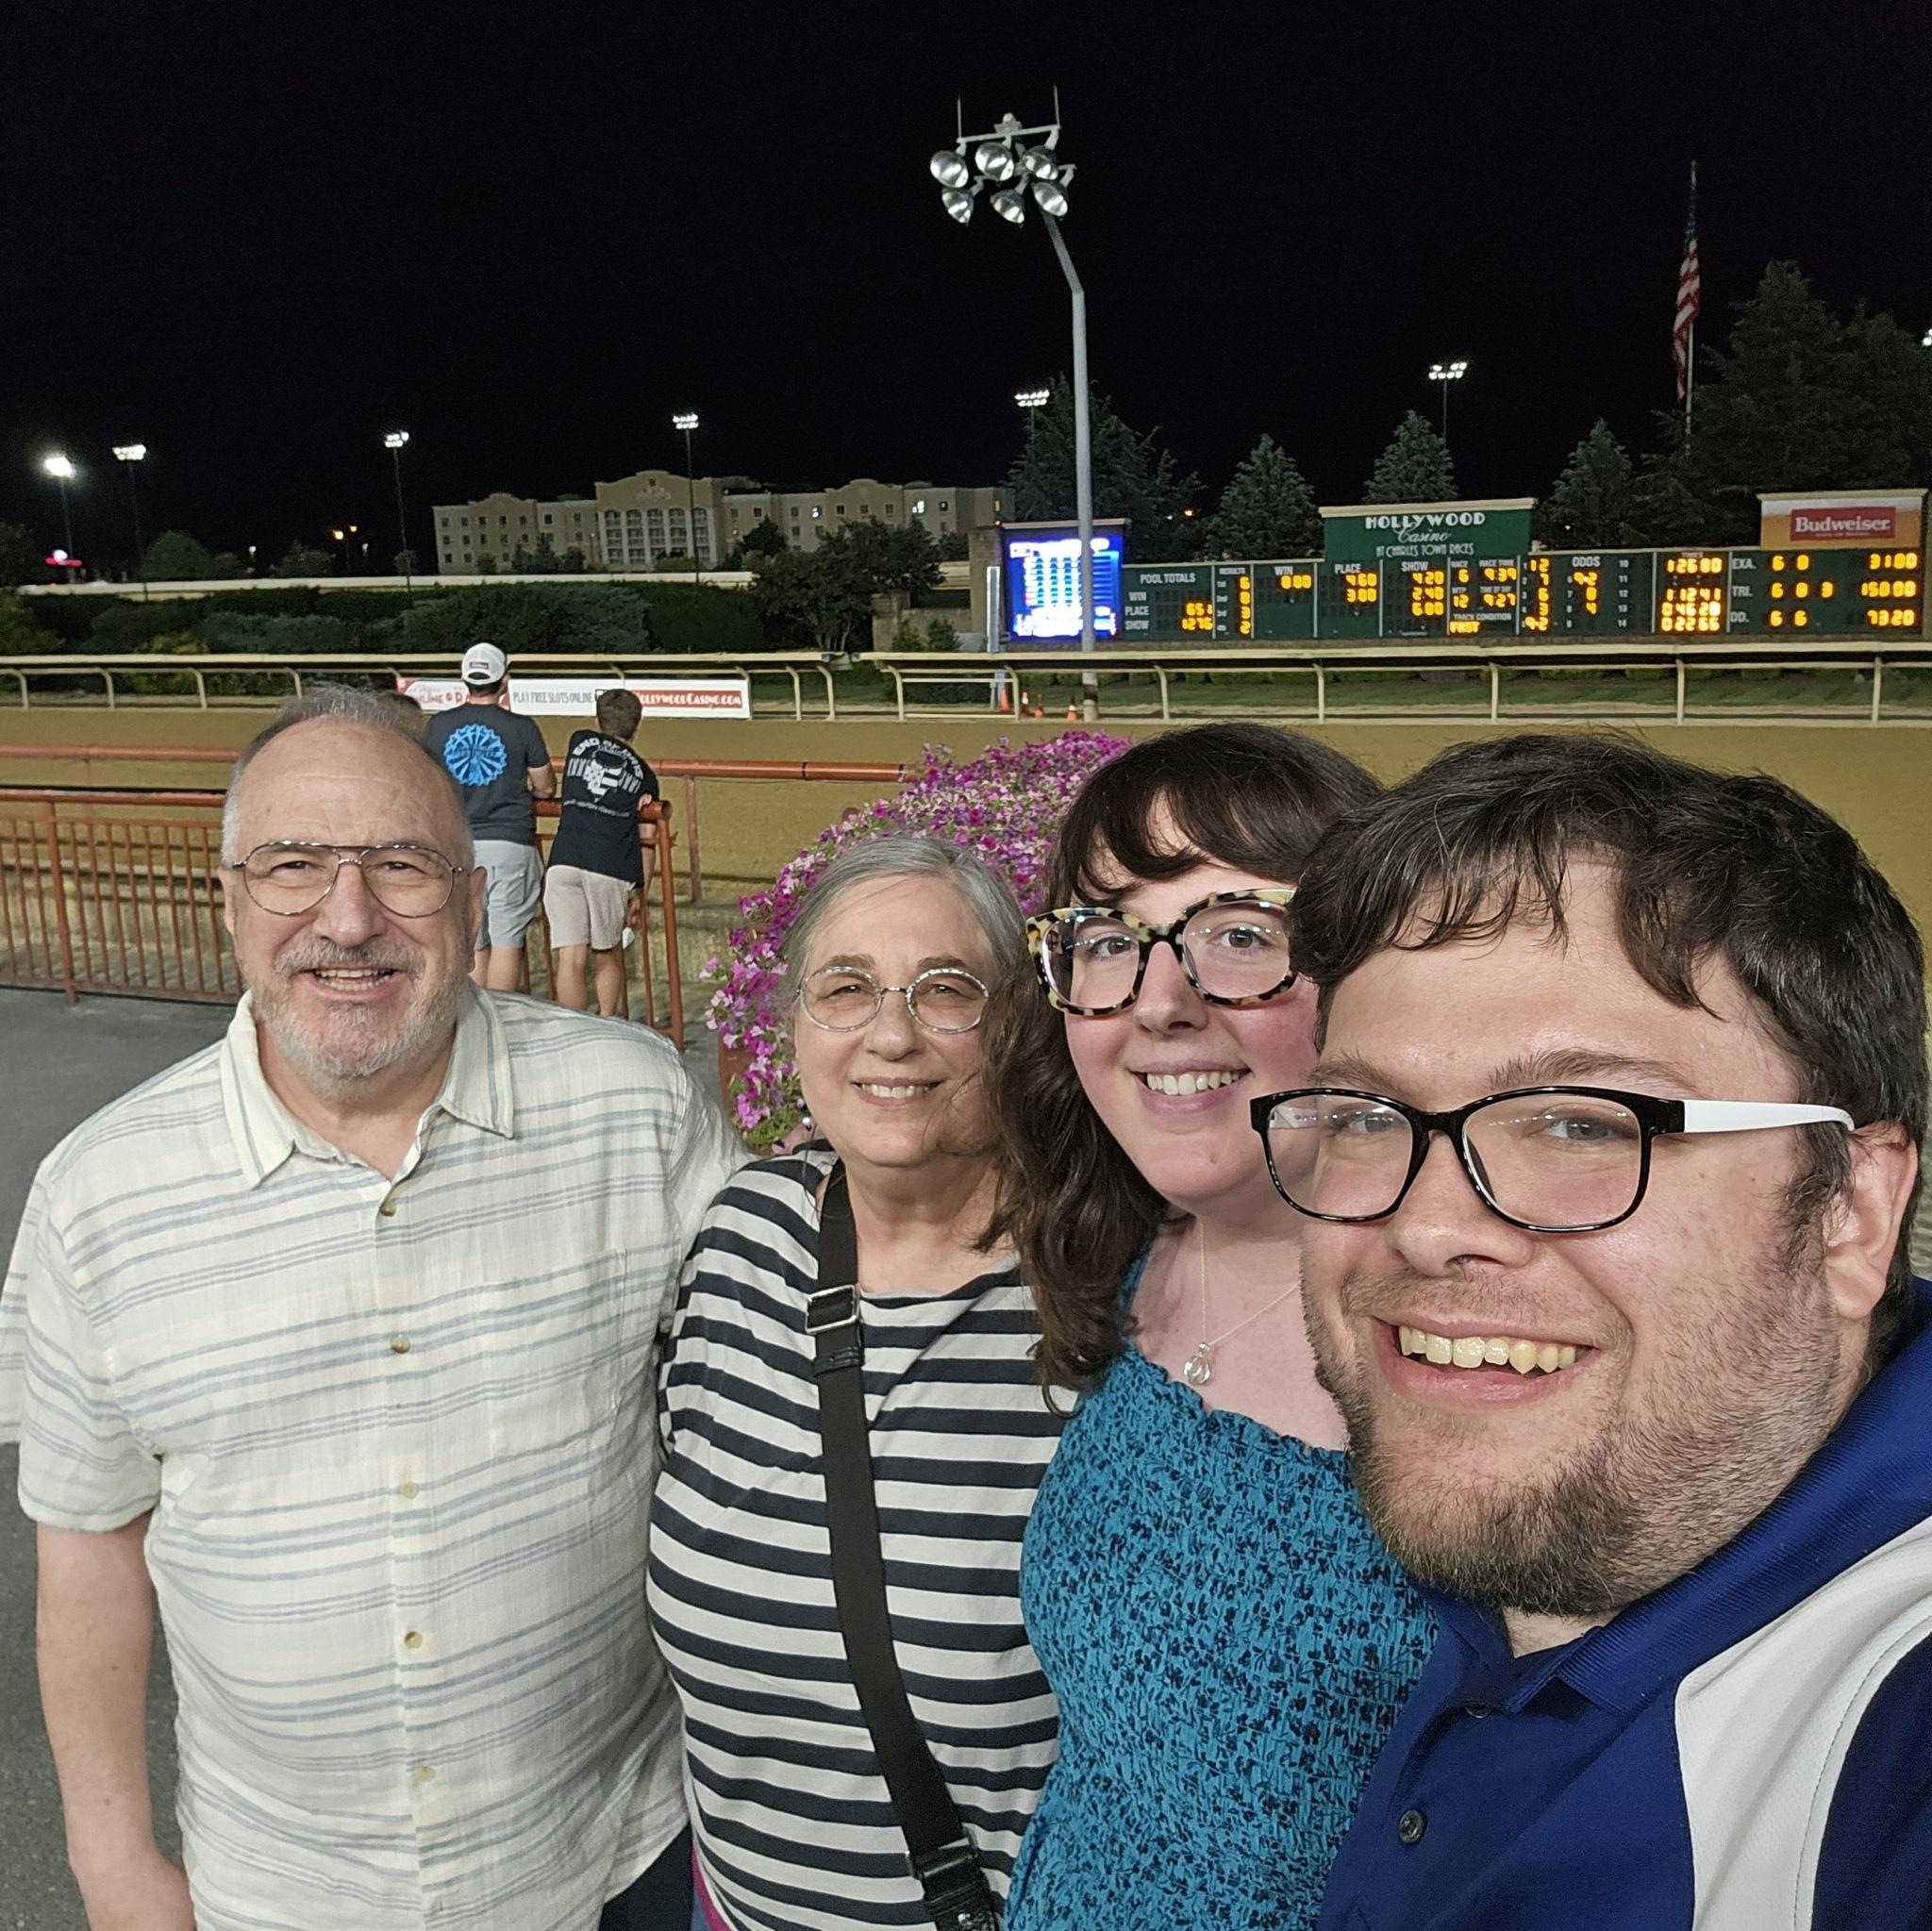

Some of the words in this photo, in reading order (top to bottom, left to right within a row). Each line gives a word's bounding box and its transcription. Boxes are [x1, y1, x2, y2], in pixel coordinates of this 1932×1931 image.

[1365, 512, 1486, 529] HOLLYWOOD
[1795, 515, 1891, 532] Budweiser
[1393, 523, 1451, 542] Casino
[1386, 545, 1419, 558] CHARLES
[1422, 545, 1447, 556] TOWN
[1449, 543, 1474, 555] RACES
[1334, 563, 1361, 574] PLACE
[1401, 561, 1428, 572] SHOW
[1572, 556, 1601, 568] ODDS
[1773, 555, 1785, 571] 6
[1274, 566, 1293, 575] WIN
[1458, 568, 1469, 583] 6
[1140, 574, 1162, 584] POOL
[1164, 573, 1196, 583] TOTALS
[1128, 591, 1147, 601] WIN
[1771, 582, 1784, 598] 6
[1821, 581, 1833, 598] 3
[1453, 593, 1469, 608] 12
[1124, 606, 1150, 616] PLACE
[1241, 606, 1251, 620] 3
[1770, 610, 1783, 626] 6
[1794, 609, 1807, 626] 6
[1124, 620, 1149, 630] SHOW
[1240, 620, 1251, 634] 2
[513, 691, 530, 704] PLAY
[531, 691, 547, 704] FREE
[549, 691, 568, 704] SLOTS
[569, 691, 594, 704] ONLINE
[573, 738, 600, 756] END
